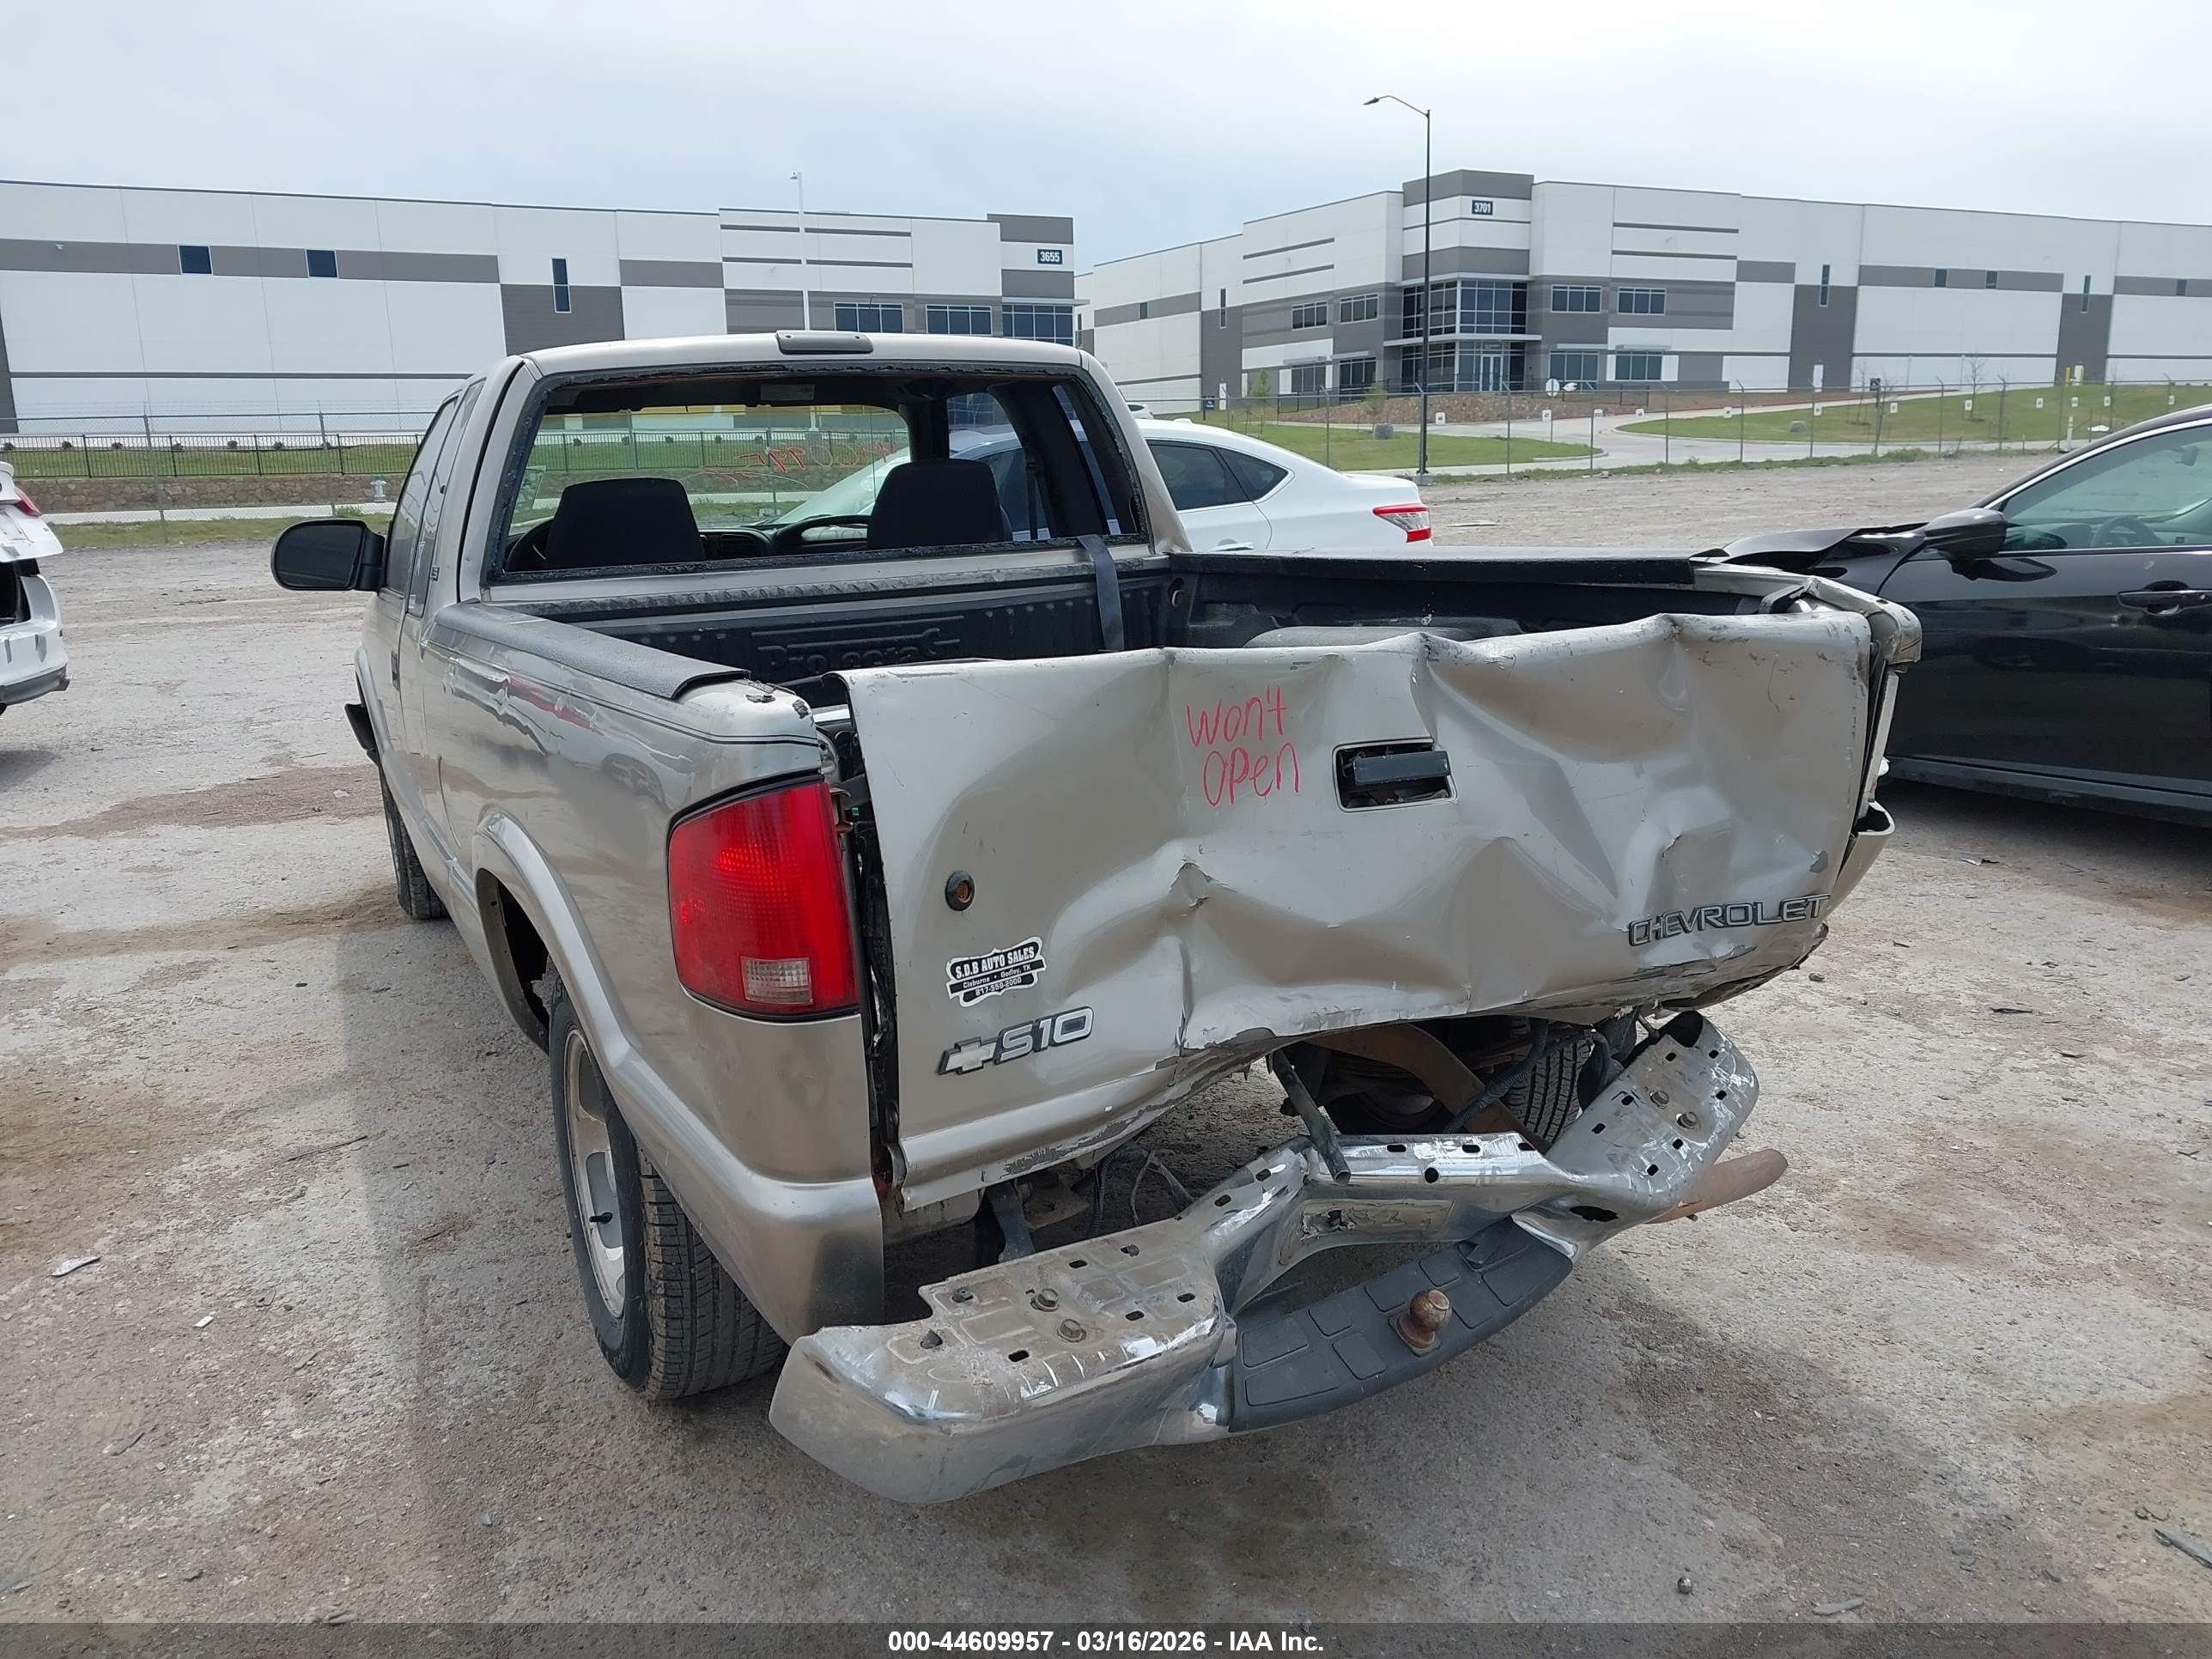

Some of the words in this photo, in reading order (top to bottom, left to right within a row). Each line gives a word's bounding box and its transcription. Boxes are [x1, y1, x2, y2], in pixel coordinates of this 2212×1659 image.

[1474, 202, 1492, 214] 3701
[1040, 251, 1060, 263] 3655
[1629, 893, 1831, 945] CHEVROLET
[955, 961, 980, 979] S.D.B
[981, 954, 1006, 972] AUTO
[1006, 946, 1035, 965] SALES
[996, 1006, 1094, 1064] S10
